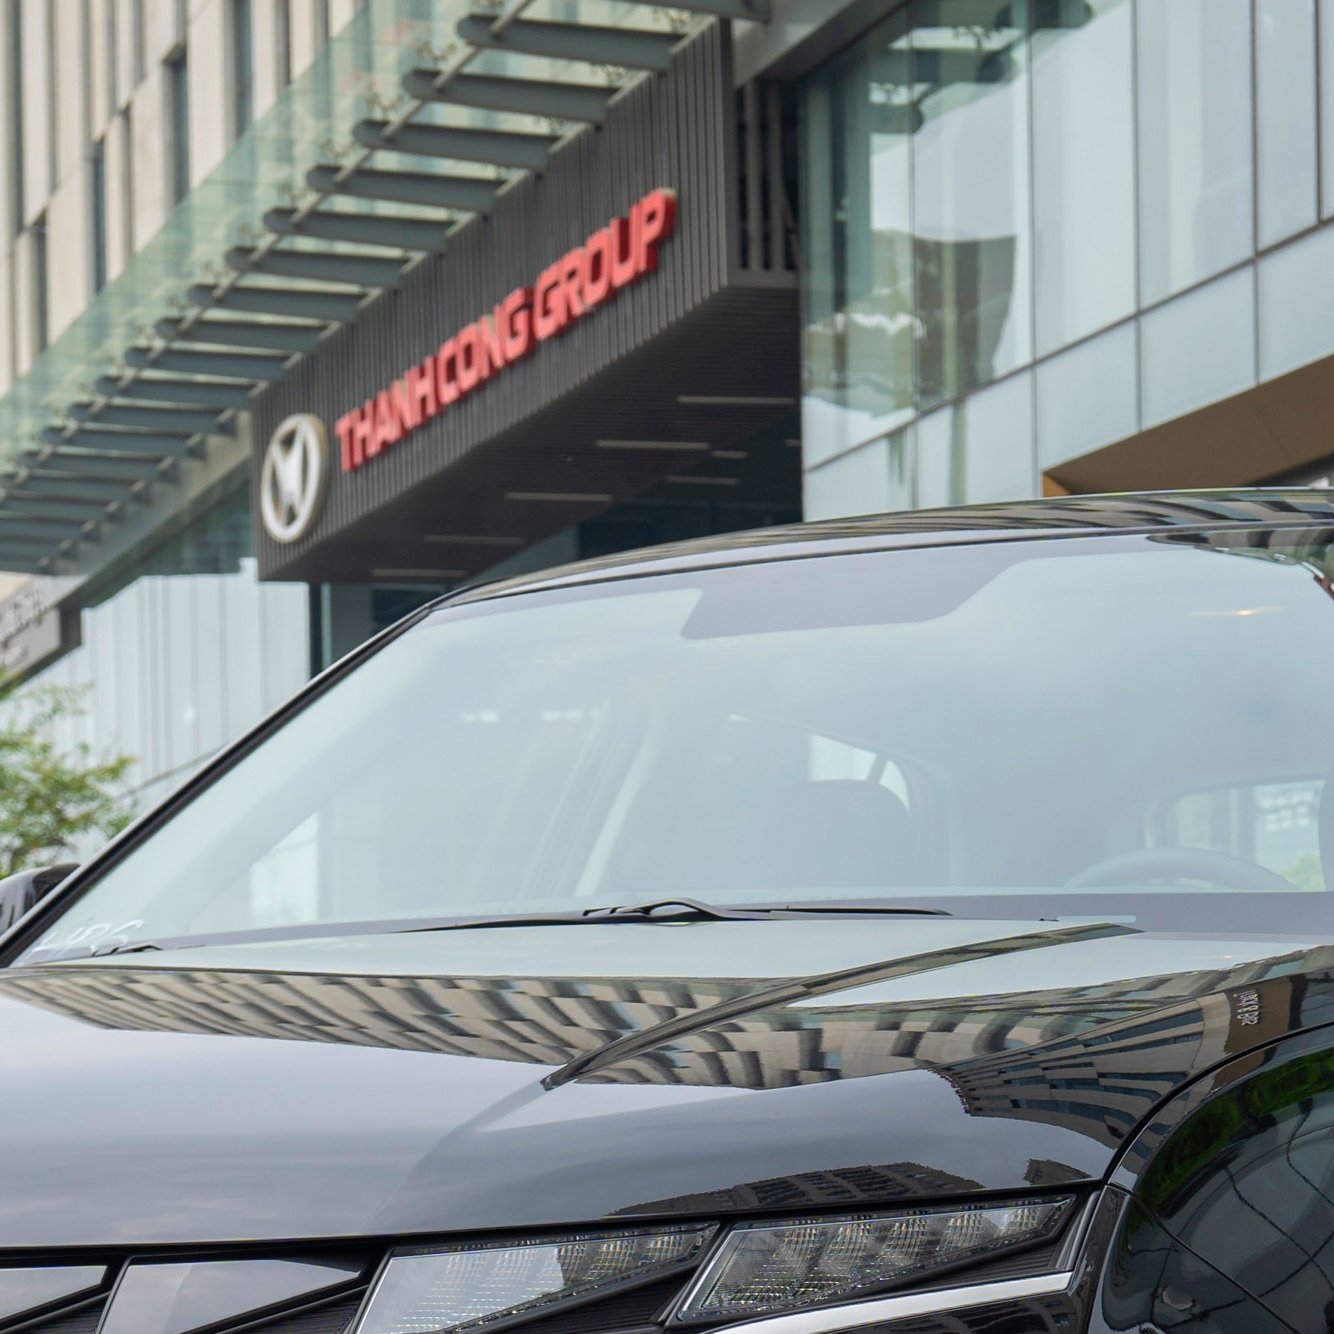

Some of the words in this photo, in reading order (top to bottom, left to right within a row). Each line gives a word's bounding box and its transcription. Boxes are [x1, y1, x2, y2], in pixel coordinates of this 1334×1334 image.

[335, 355, 440, 472] THANH
[436, 287, 537, 408] CONG
[533, 187, 677, 341] GROUP
